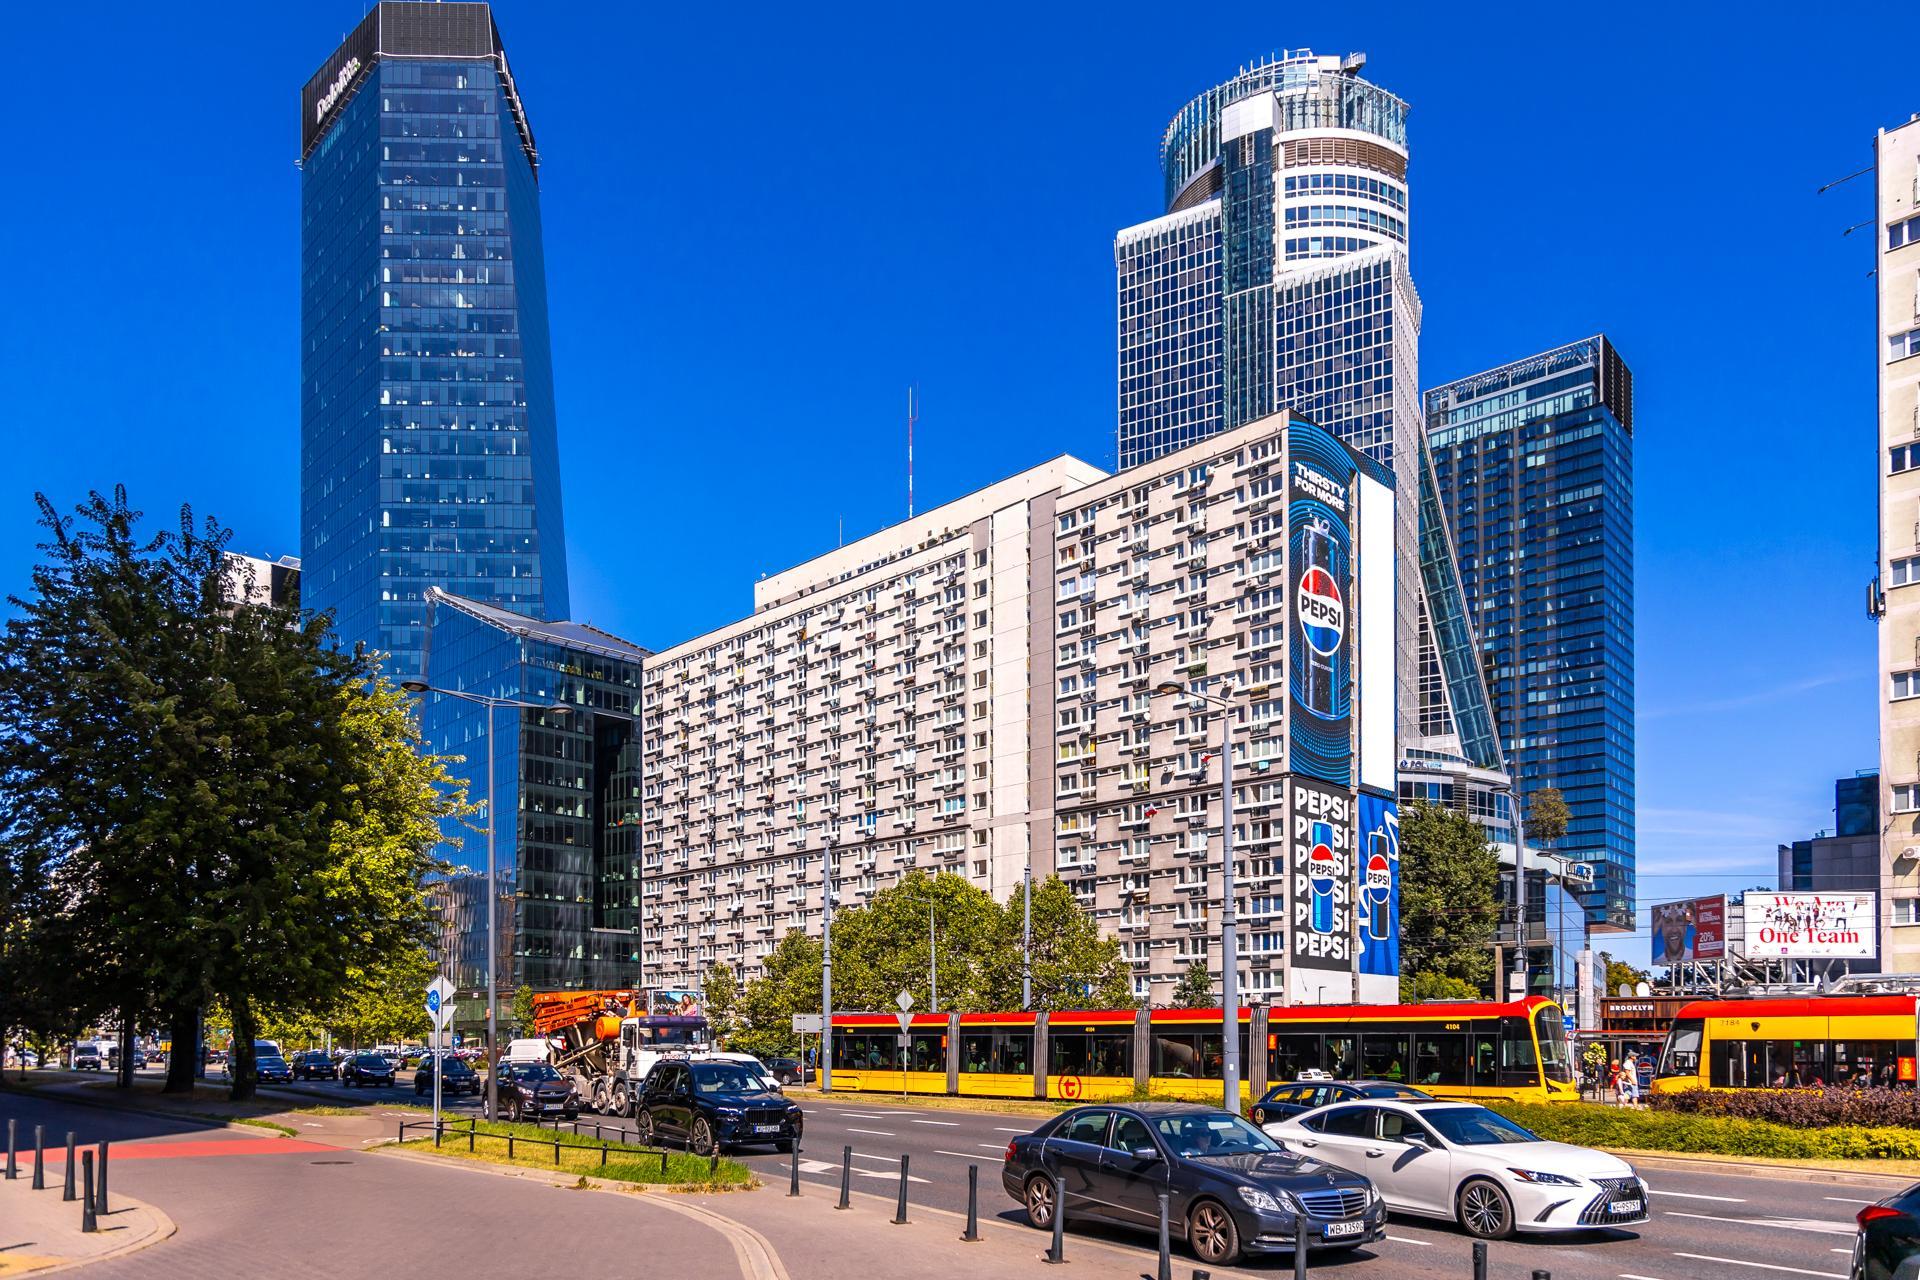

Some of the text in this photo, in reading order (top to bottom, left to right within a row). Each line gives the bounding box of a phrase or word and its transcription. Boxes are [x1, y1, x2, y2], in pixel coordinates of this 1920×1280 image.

[1295, 461, 1345, 498] THIRSTY
[1295, 475, 1345, 511] FOR MORE
[1301, 594, 1341, 628] PEPSI
[1295, 786, 1349, 822] PEPSI
[1295, 815, 1349, 850] PSI
[1310, 863, 1334, 876] PEPSI
[1368, 872, 1390, 886] PEPSI
[1295, 931, 1350, 960] PEPSI
[1700, 931, 1715, 942] 20%
[1760, 927, 1859, 943] One Team
[1329, 1224, 1341, 1234] WB
